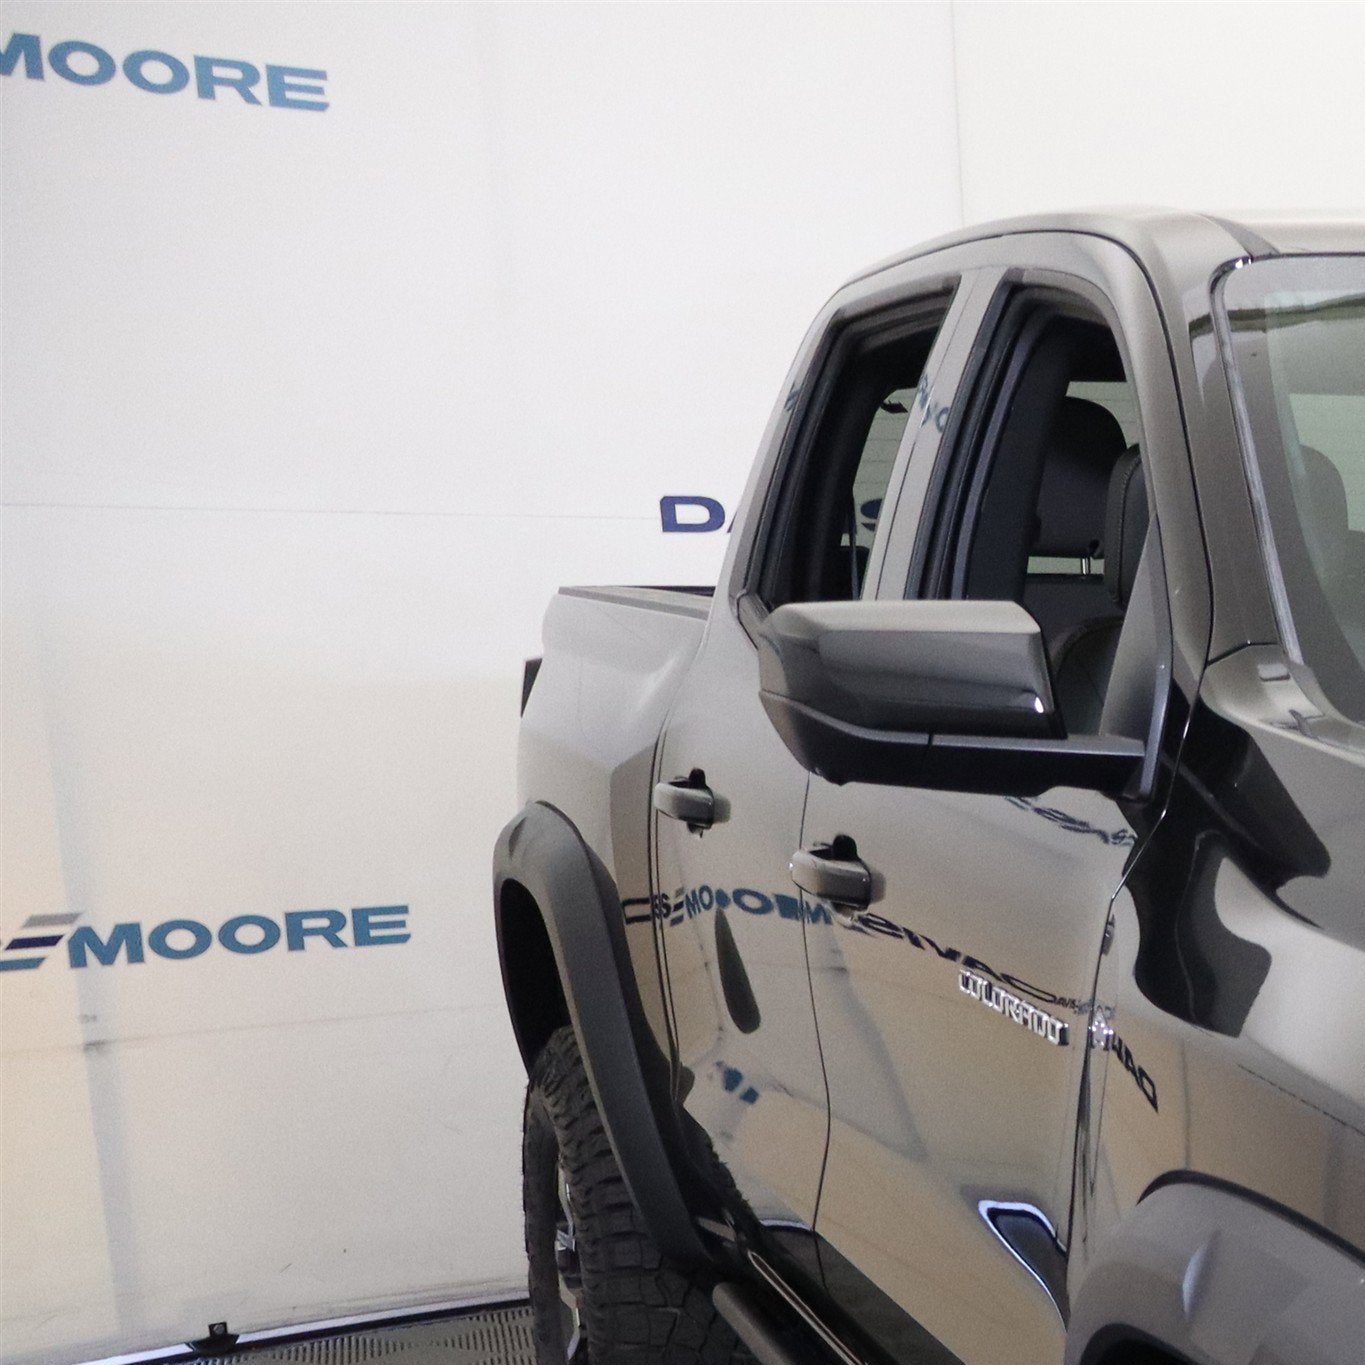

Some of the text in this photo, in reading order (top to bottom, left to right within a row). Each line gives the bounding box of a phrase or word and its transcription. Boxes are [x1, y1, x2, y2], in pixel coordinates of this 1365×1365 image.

[0, 32, 330, 112] MOORE
[66, 904, 412, 969] MOORE
[959, 968, 1070, 1046] COLORADO
